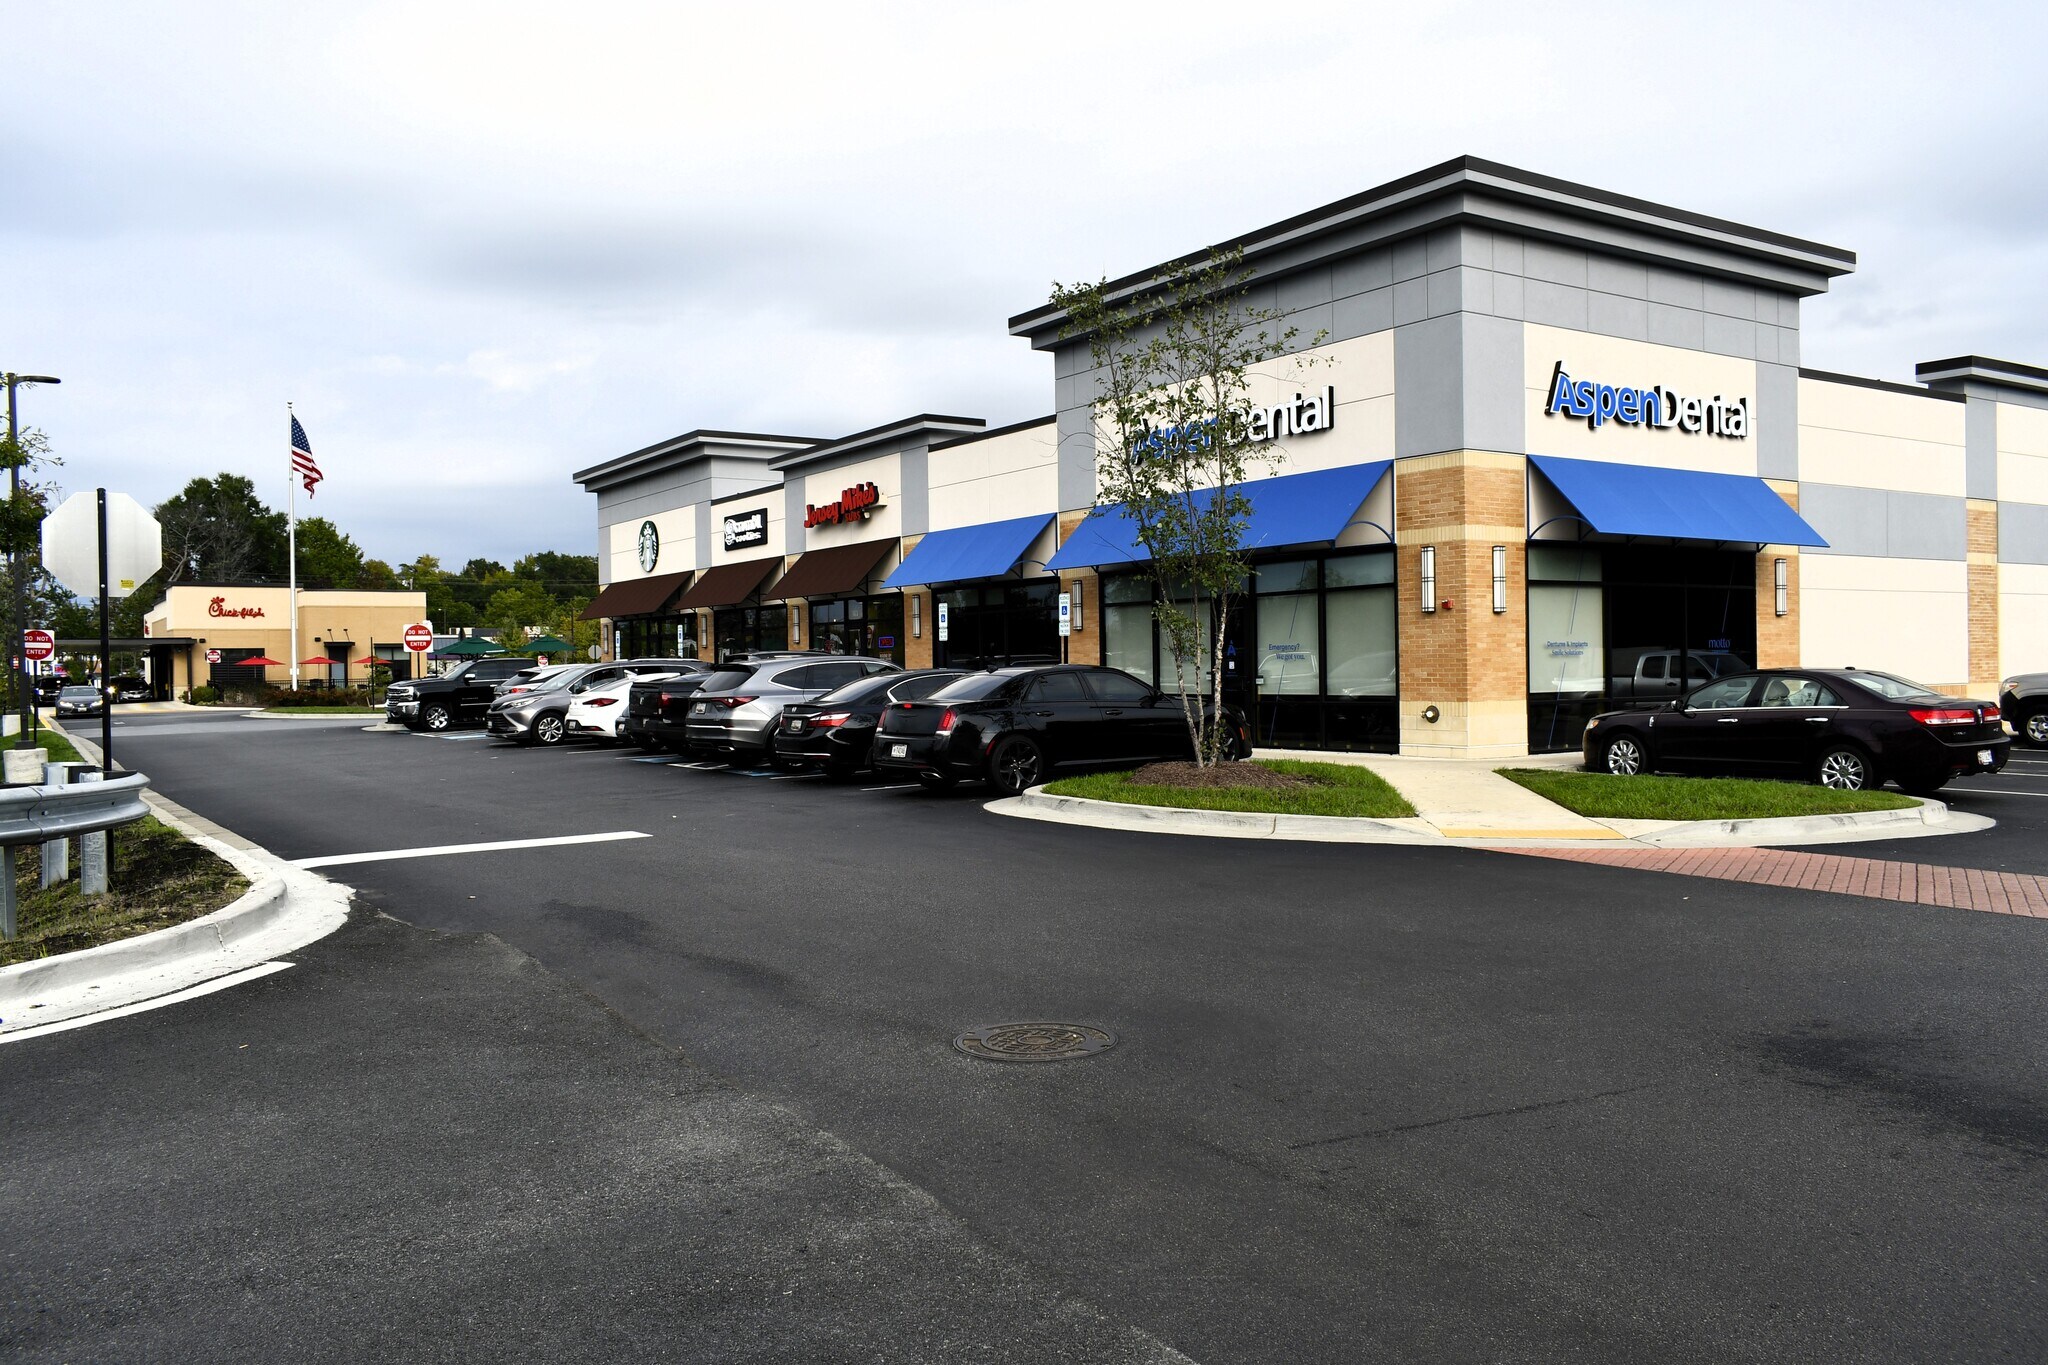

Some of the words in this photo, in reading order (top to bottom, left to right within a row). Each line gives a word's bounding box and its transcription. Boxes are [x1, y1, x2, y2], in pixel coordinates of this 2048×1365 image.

[1547, 361, 1752, 438] AspenDental
[804, 503, 842, 529] Jersey
[841, 482, 880, 514] Mike's
[1268, 643, 1300, 651] Emergency?
[1708, 638, 1731, 649] motto
